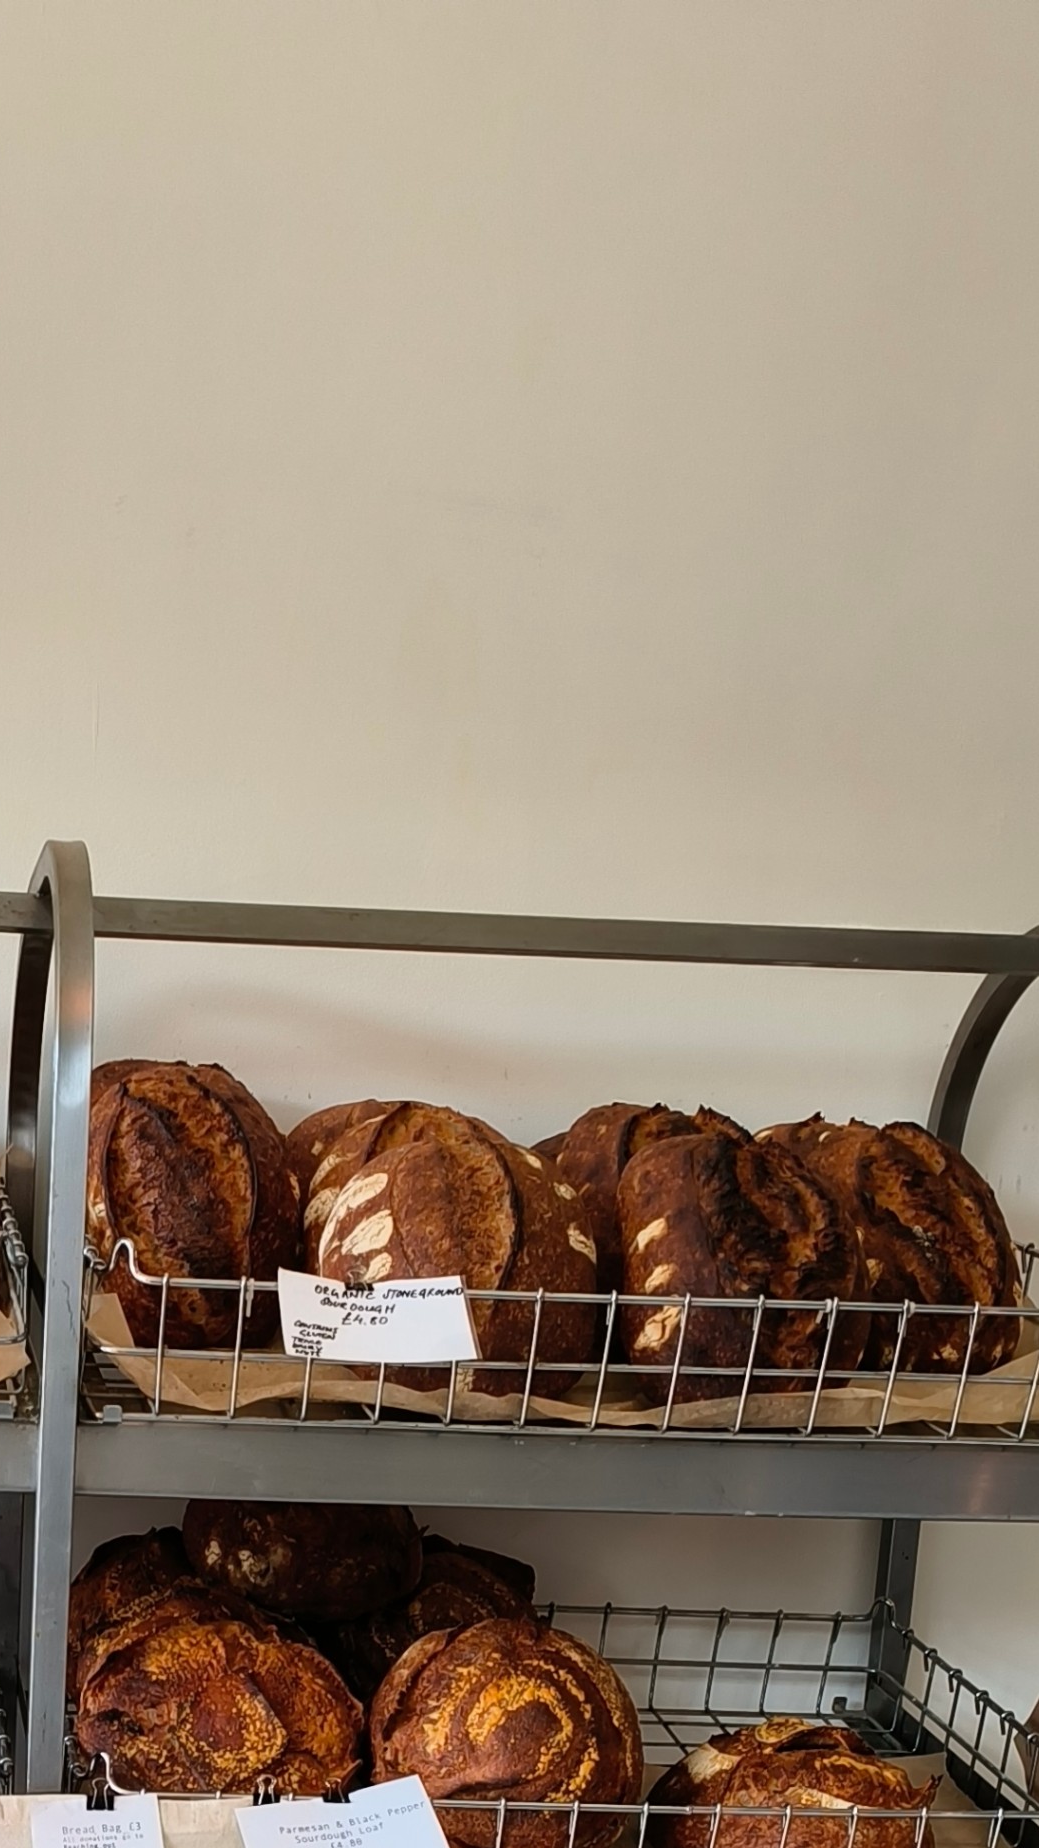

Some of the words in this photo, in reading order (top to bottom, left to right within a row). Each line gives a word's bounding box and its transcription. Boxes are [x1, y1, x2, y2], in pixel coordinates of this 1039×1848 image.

[62, 1826, 96, 1834] Bread
[102, 1824, 121, 1833] Bag
[129, 1822, 141, 1831] £3
[279, 1822, 330, 1835] Parmesan
[349, 1813, 381, 1826] Black
[387, 1801, 425, 1817] Pepper
[294, 1830, 353, 1844] Sourdough
[358, 1822, 384, 1835] Loaf
